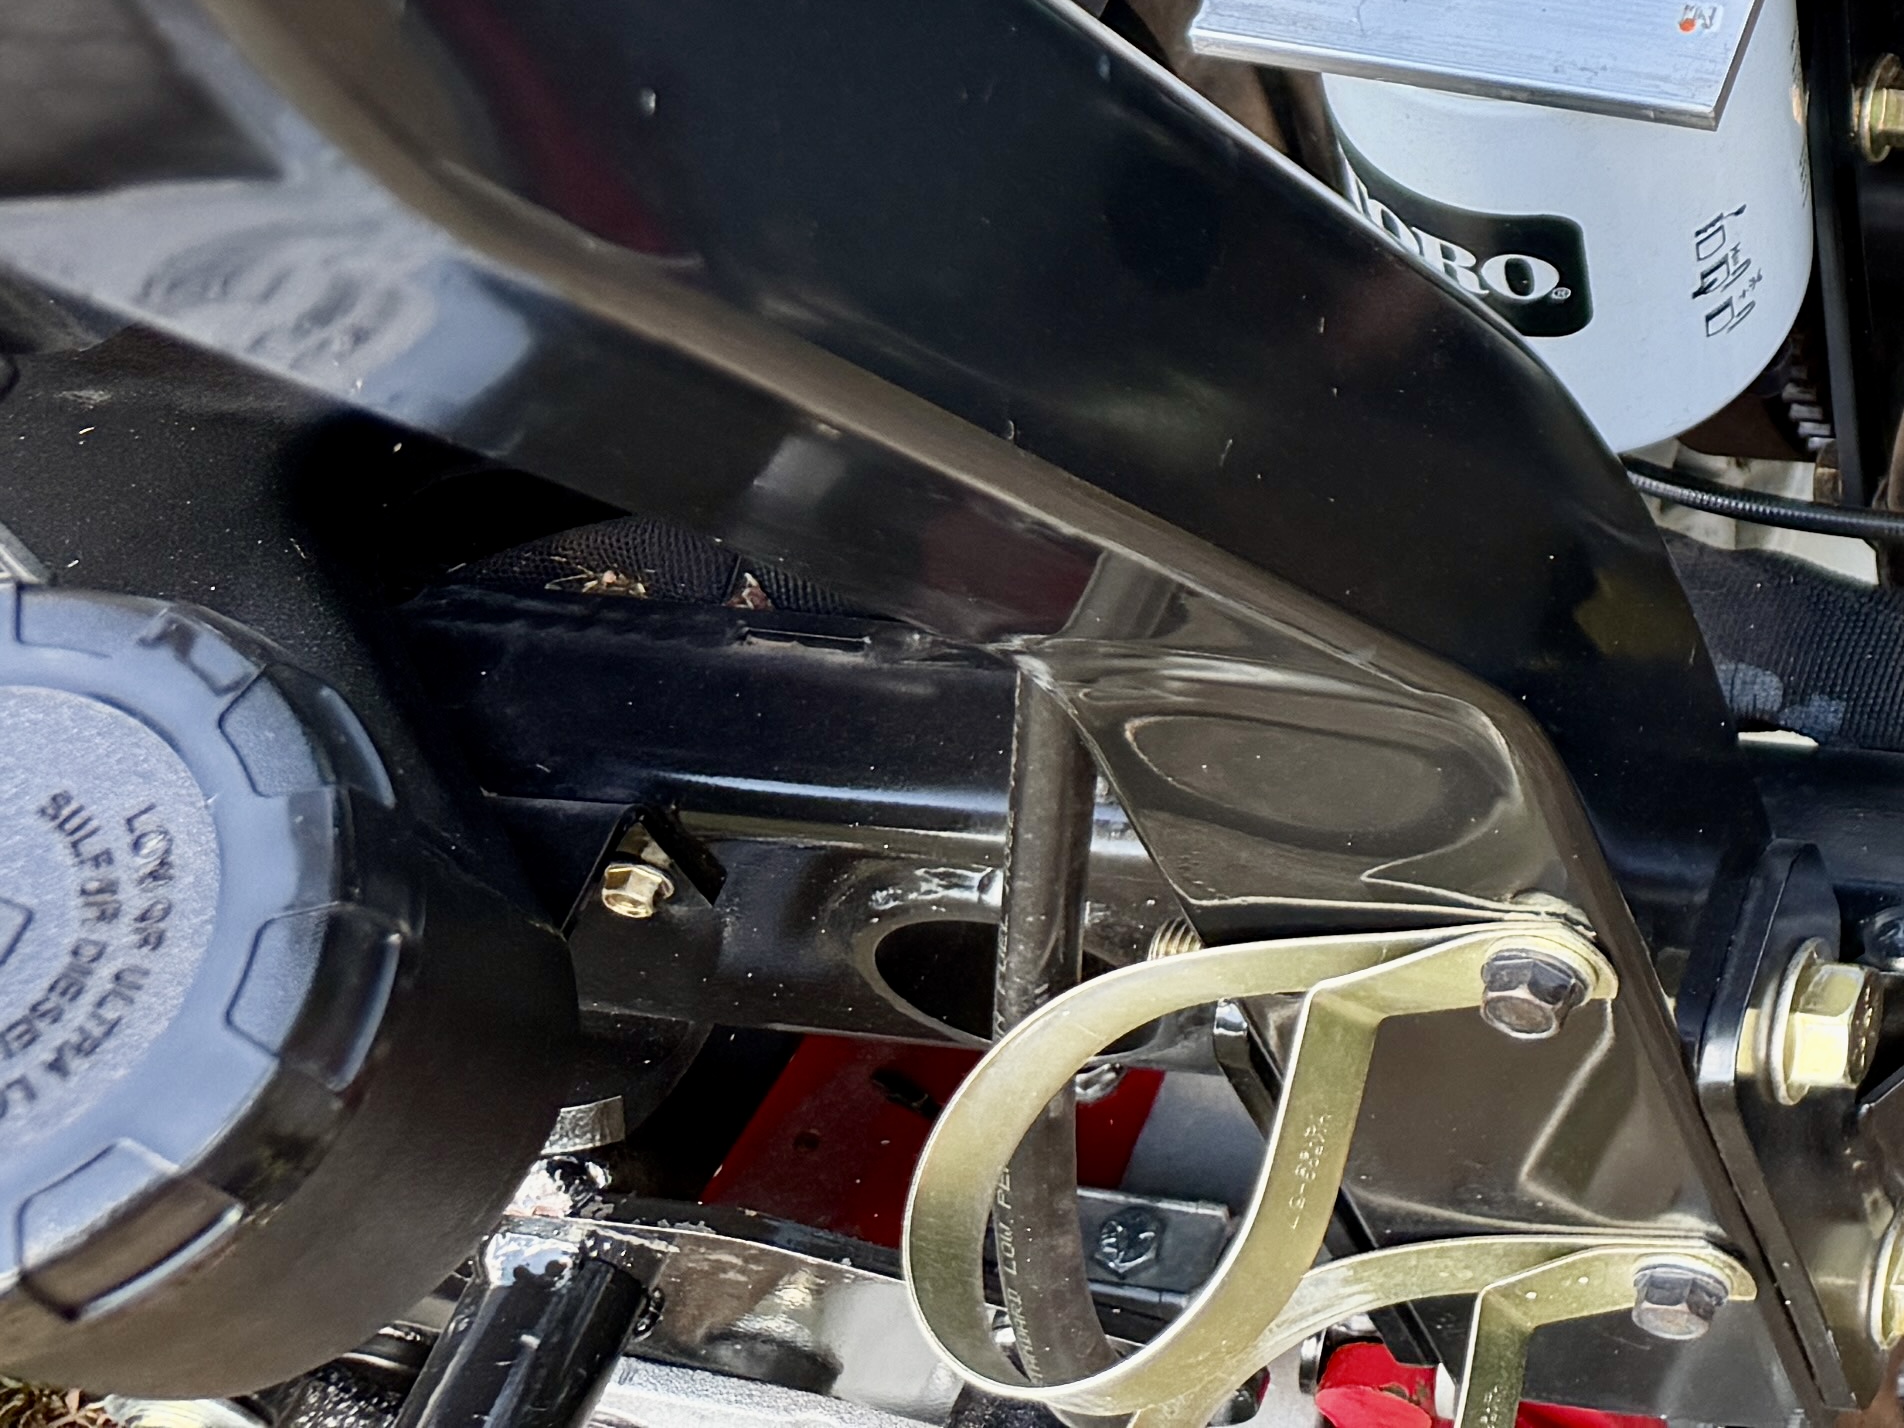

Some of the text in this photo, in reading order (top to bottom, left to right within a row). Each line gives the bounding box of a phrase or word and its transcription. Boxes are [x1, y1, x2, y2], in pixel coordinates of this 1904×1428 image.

[33, 789, 122, 926] SULFUR
[123, 802, 174, 894] LOW
[43, 964, 150, 1083] ULTRA
